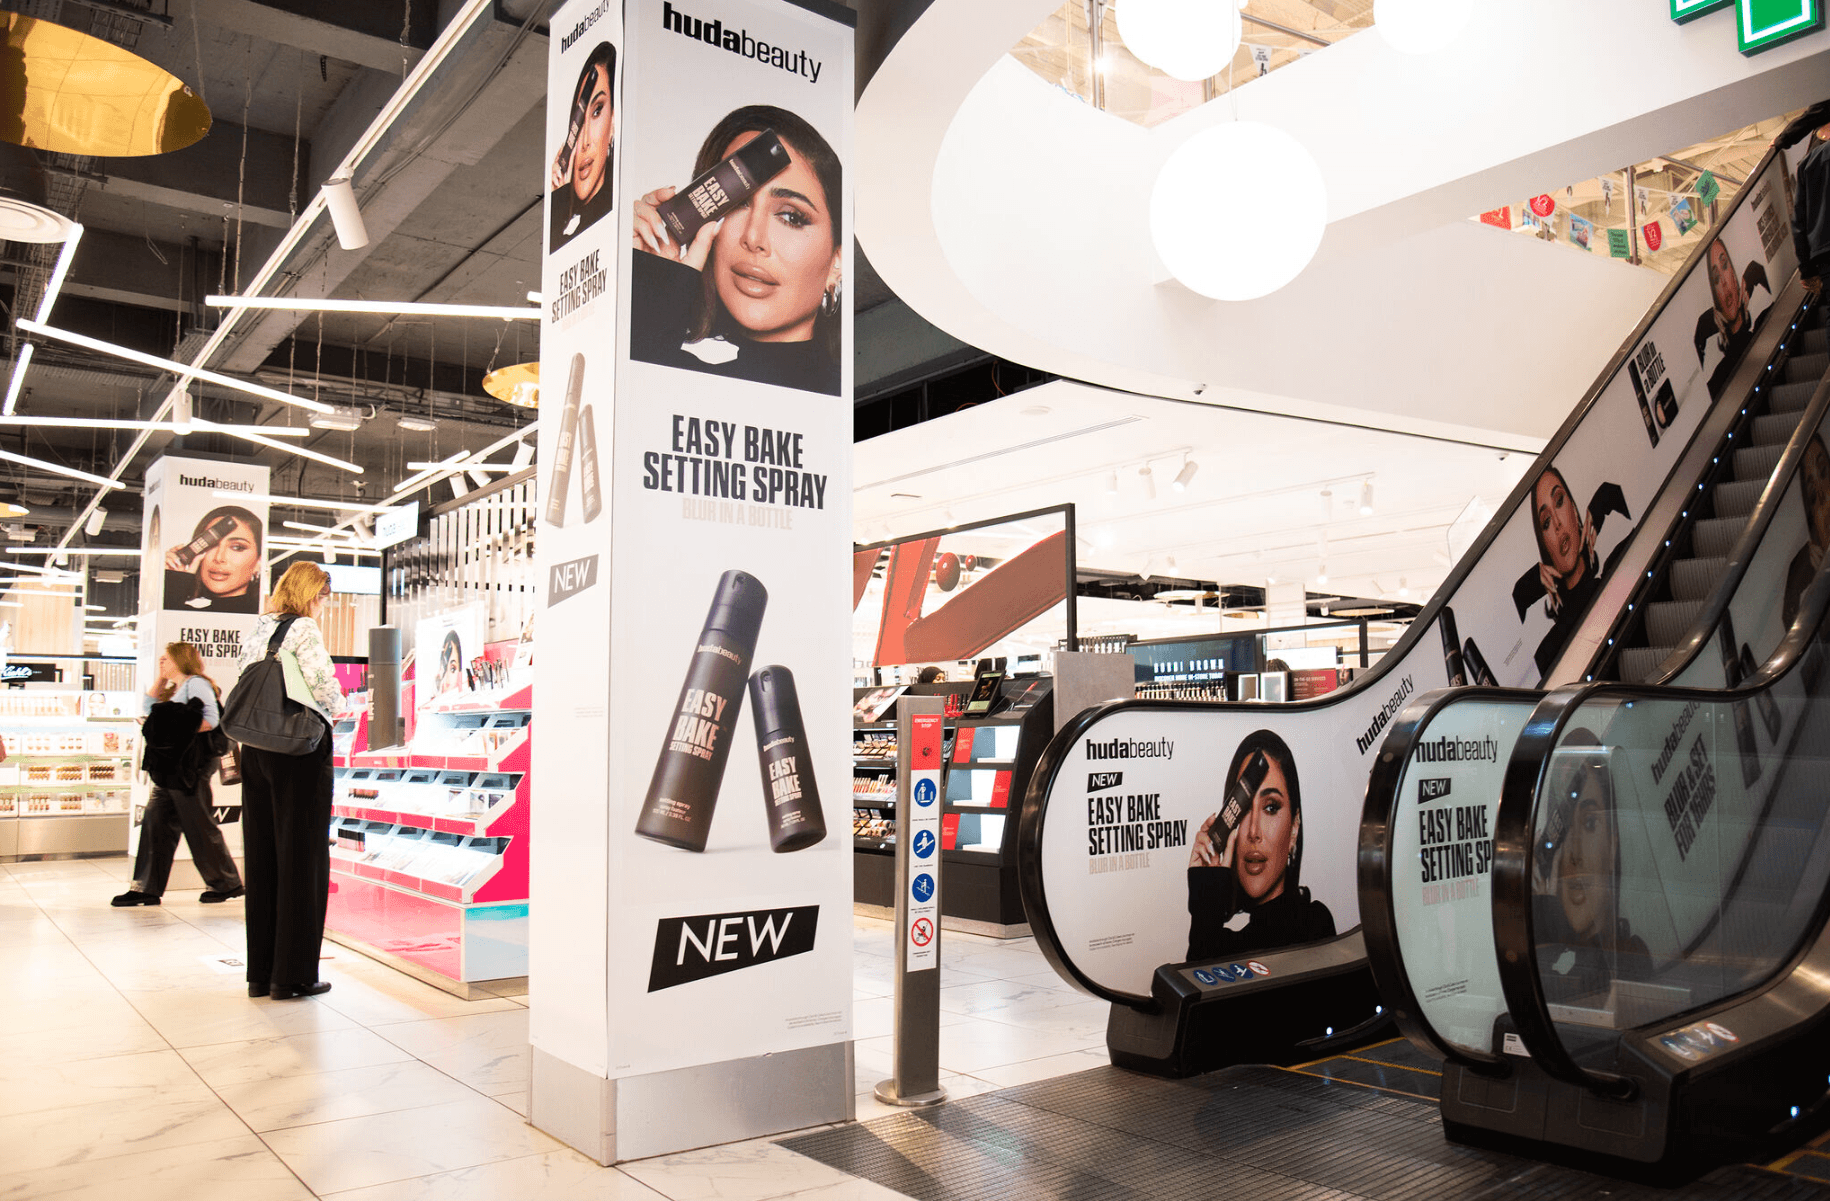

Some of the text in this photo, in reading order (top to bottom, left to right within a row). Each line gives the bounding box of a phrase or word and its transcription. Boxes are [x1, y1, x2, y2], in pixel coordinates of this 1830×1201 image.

[561, 0, 609, 55] hudabeauty
[663, 0, 822, 84] hudabeauty
[692, 185, 718, 217] BAKE
[703, 176, 730, 207] EASY
[560, 248, 600, 296] EASY BAKE
[551, 285, 581, 324] SETTING
[582, 267, 608, 305] SPRAY
[672, 414, 804, 470] EASY BAKE
[179, 473, 255, 493] hudabeauty
[643, 450, 746, 501] SETTING
[752, 465, 827, 510] SPRAY
[682, 497, 793, 531] BLUR IN A BOTTLE
[554, 559, 591, 594] NEW
[180, 627, 240, 644] EASY BAKE
[216, 643, 243, 658] SPR
[1153, 658, 1224, 674] BOBBI BROWN
[681, 688, 728, 722] EASY
[1356, 673, 1414, 756] hudabeauty
[672, 714, 720, 751] BAKE
[1085, 736, 1174, 760] hudabeauty
[769, 756, 796, 781] EASY
[1091, 773, 1118, 787] NEW
[771, 774, 801, 800] BAKE
[1422, 780, 1447, 797] NEW
[1088, 793, 1160, 826] EASY BAKE
[1419, 805, 1488, 846] EASY BAKE
[1088, 823, 1144, 856] SETTING
[1147, 819, 1188, 850] SPRAY
[1089, 857, 1108, 875] BLUR
[1125, 852, 1150, 870] BOTTLE
[1420, 843, 1474, 883] SETTING
[676, 912, 793, 966] NEW
